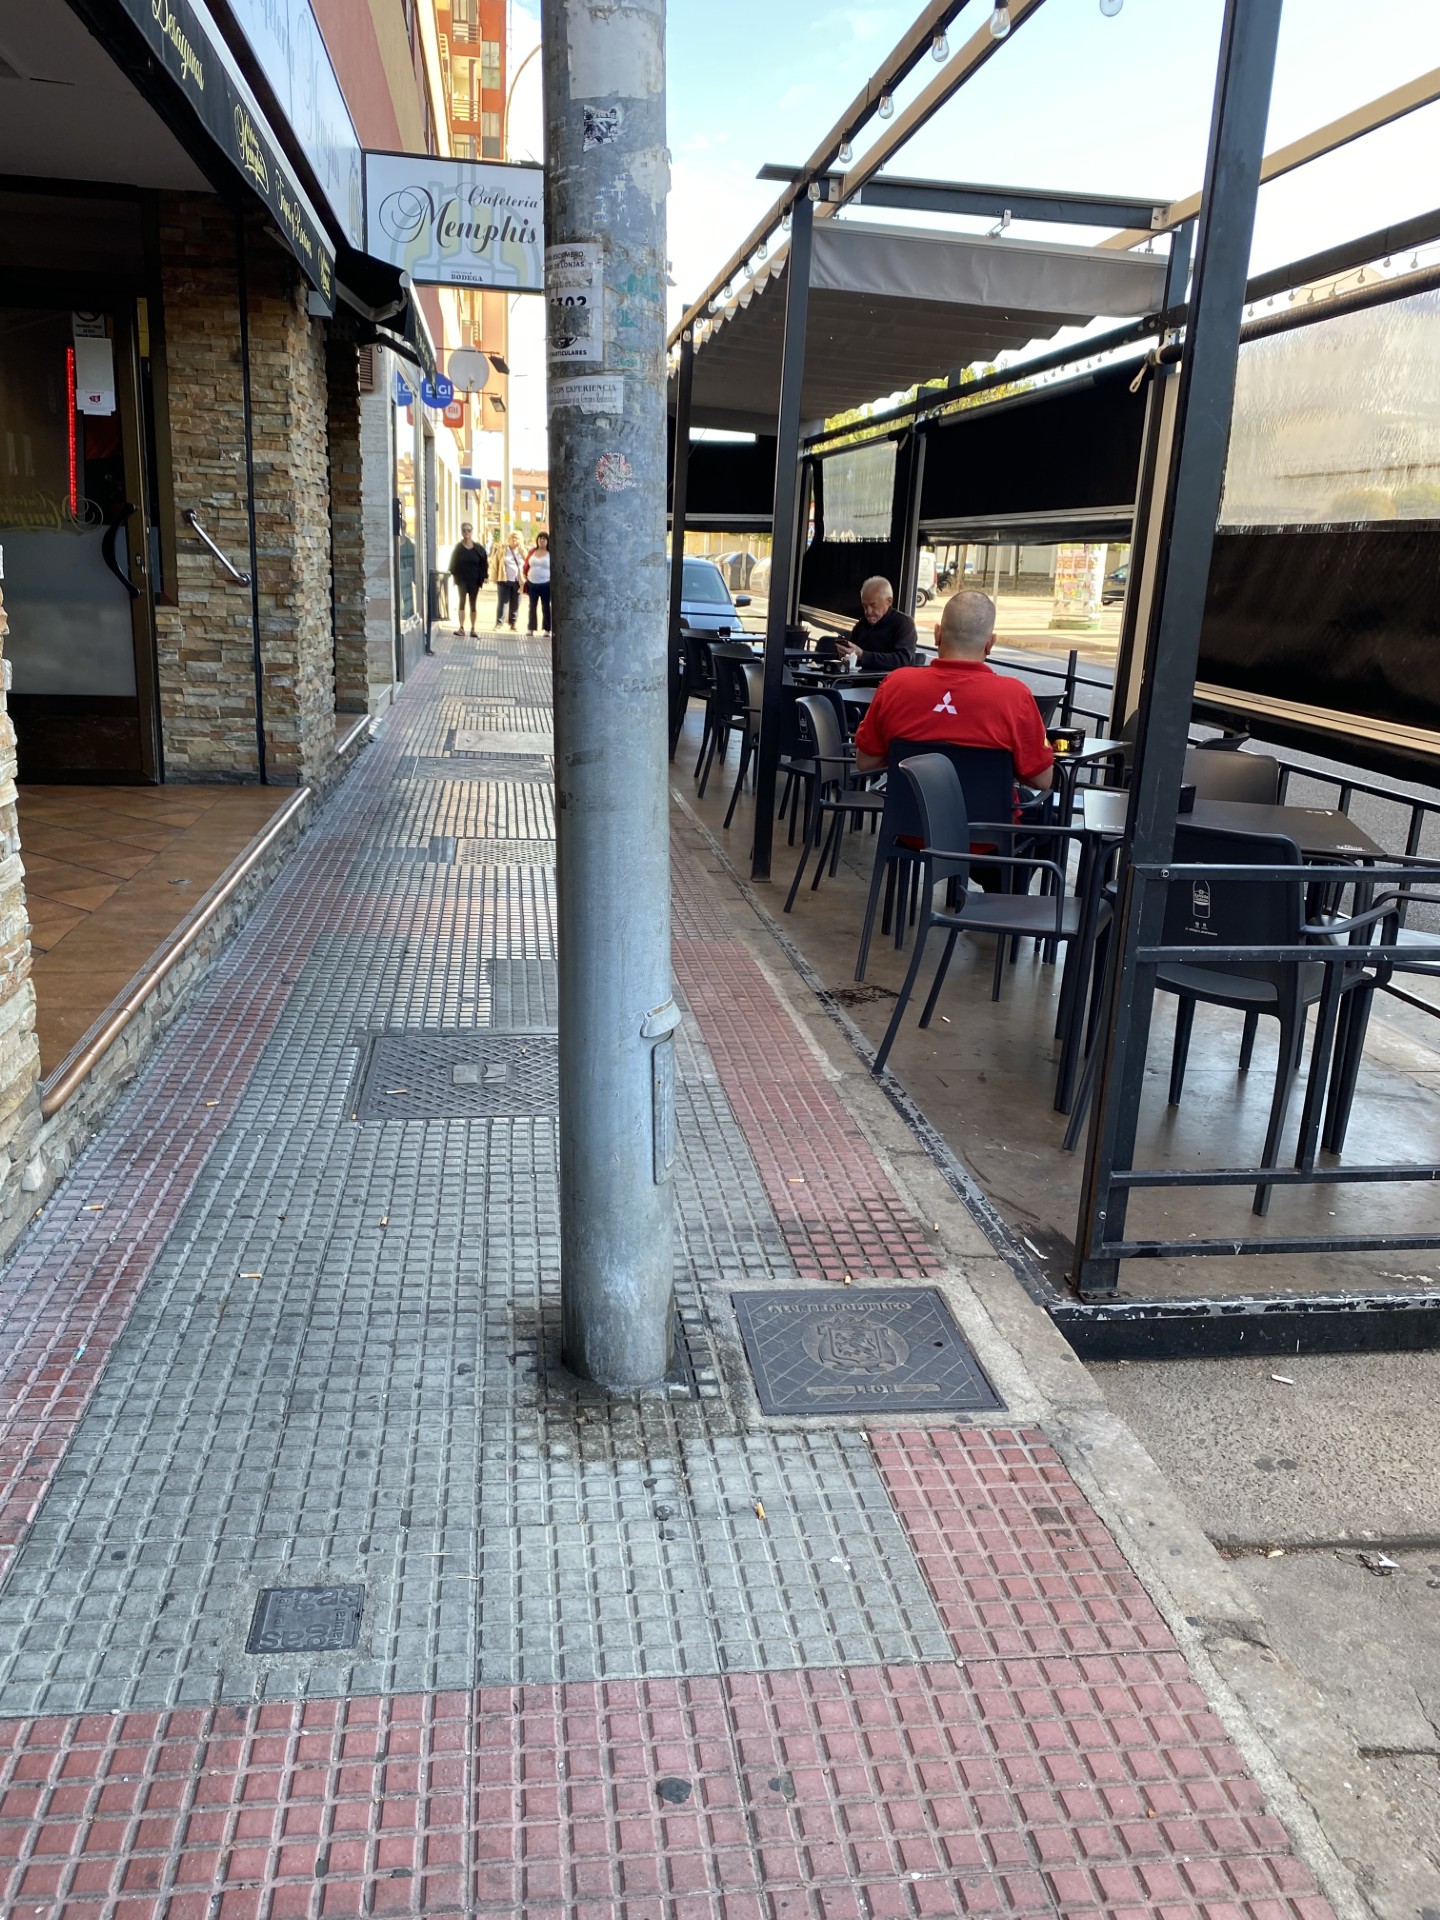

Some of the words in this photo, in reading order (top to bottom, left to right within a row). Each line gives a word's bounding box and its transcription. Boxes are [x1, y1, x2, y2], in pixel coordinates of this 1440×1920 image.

[455, 182, 540, 210] Cafetería
[378, 185, 539, 254] Memphis
[451, 274, 483, 282] BODEGA
[425, 384, 451, 395] DGI
[566, 383, 617, 394] EXPERIENCIA
